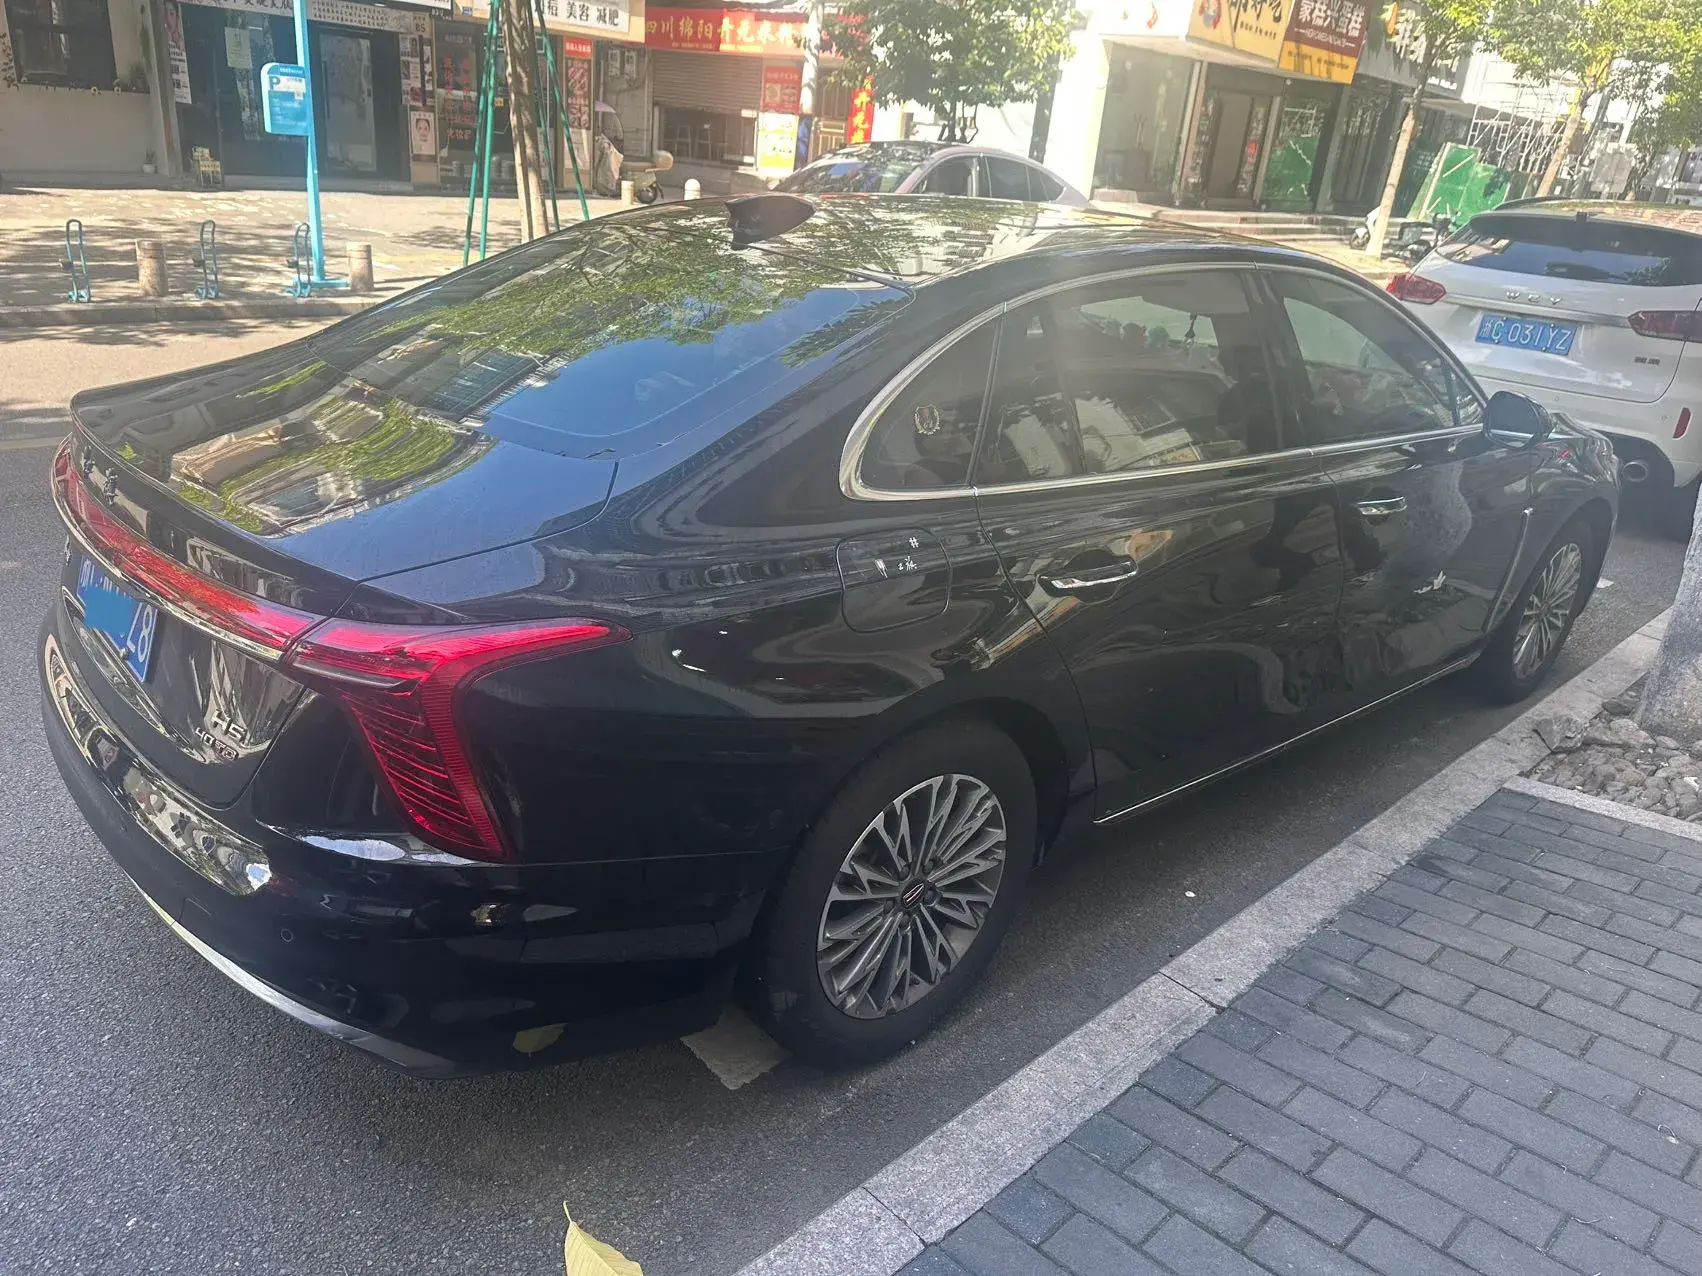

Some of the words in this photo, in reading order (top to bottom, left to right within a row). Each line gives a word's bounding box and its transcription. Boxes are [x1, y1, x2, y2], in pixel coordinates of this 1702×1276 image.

[566, 2, 590, 22] 美容
[596, 8, 620, 26] 减肥
[269, 76, 281, 90] P
[1505, 289, 1563, 306] WEY
[209, 708, 248, 746] H5
